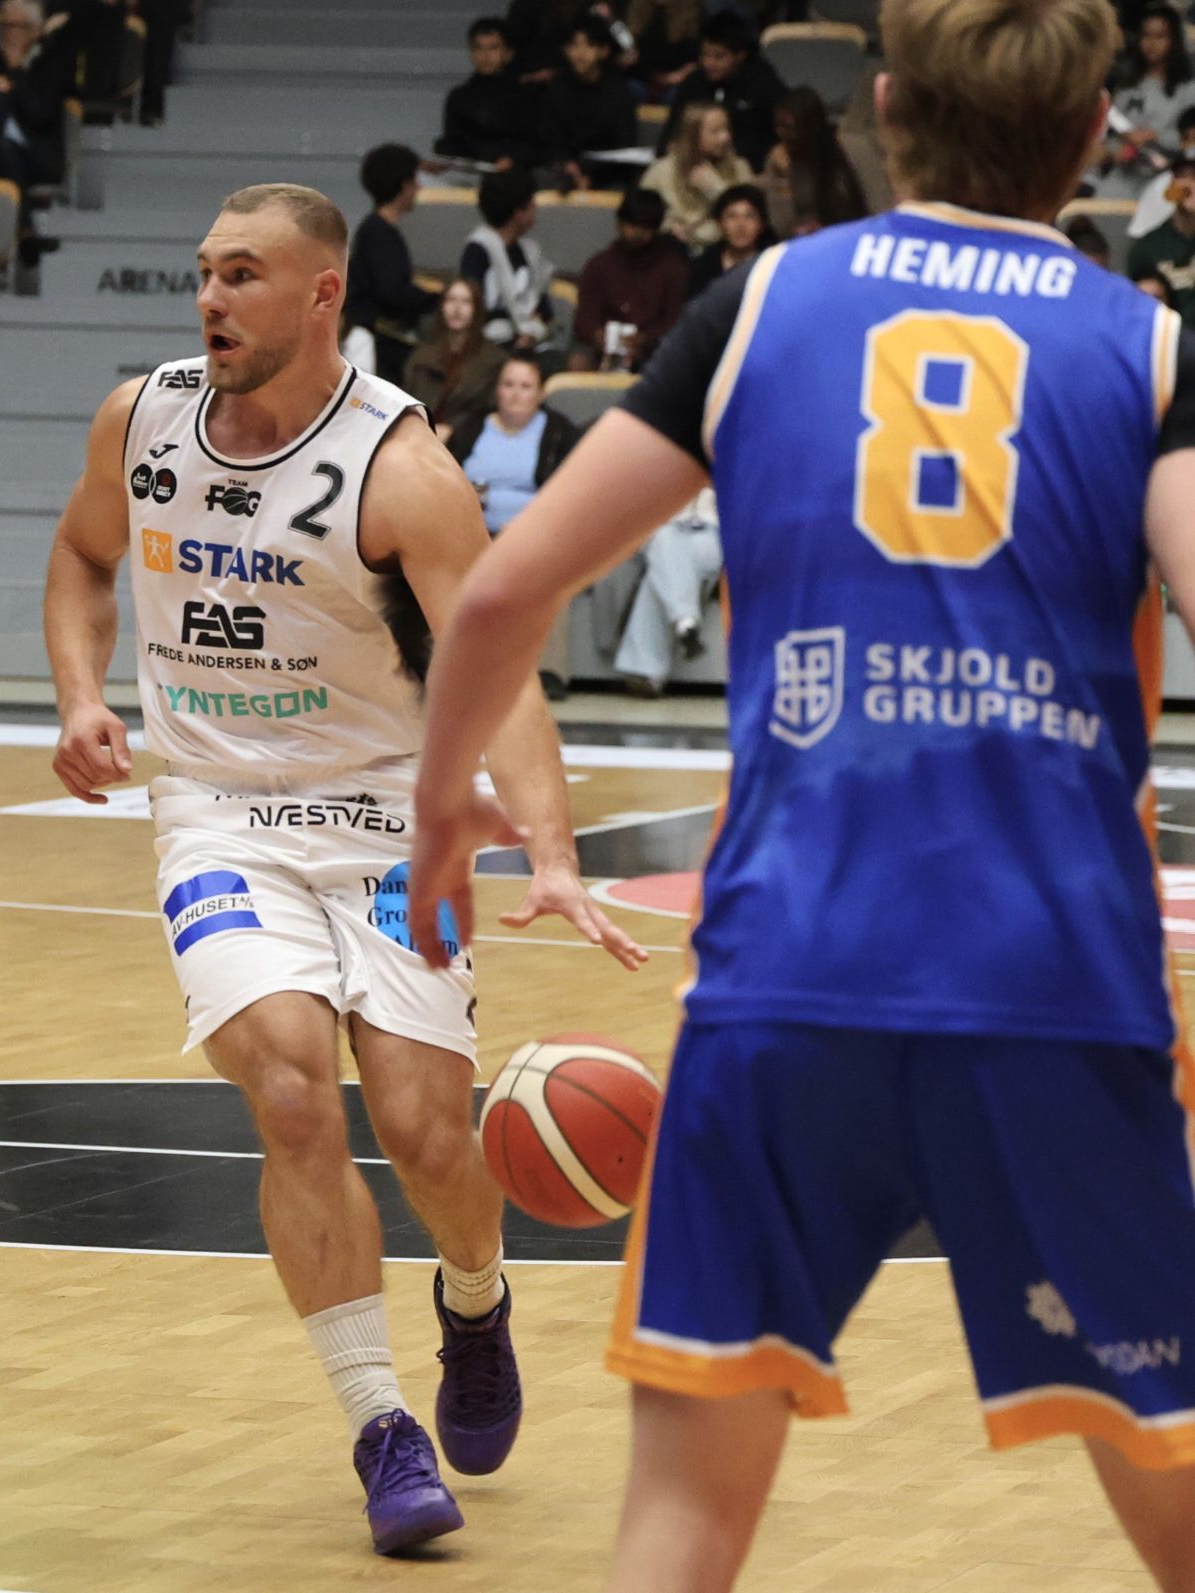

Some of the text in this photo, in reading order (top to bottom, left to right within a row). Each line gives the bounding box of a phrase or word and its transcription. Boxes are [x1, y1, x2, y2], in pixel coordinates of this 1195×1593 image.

[96, 266, 199, 293] ARENA
[850, 233, 1077, 298] HEMING
[157, 369, 204, 389] FAS
[359, 402, 388, 420] STARK
[852, 306, 1030, 569] 8
[228, 479, 248, 487] TEAM
[287, 460, 346, 541] 2
[178, 539, 305, 586] STARK
[181, 600, 267, 650] FAS
[148, 643, 318, 671] FREDE ANDERSEN & SØN
[865, 643, 1055, 697] SKJOLD
[158, 682, 328, 719] YNTEGON
[863, 685, 1101, 750] GRUPPEN
[362, 876, 409, 897] Dan
[367, 906, 408, 928] Gro
